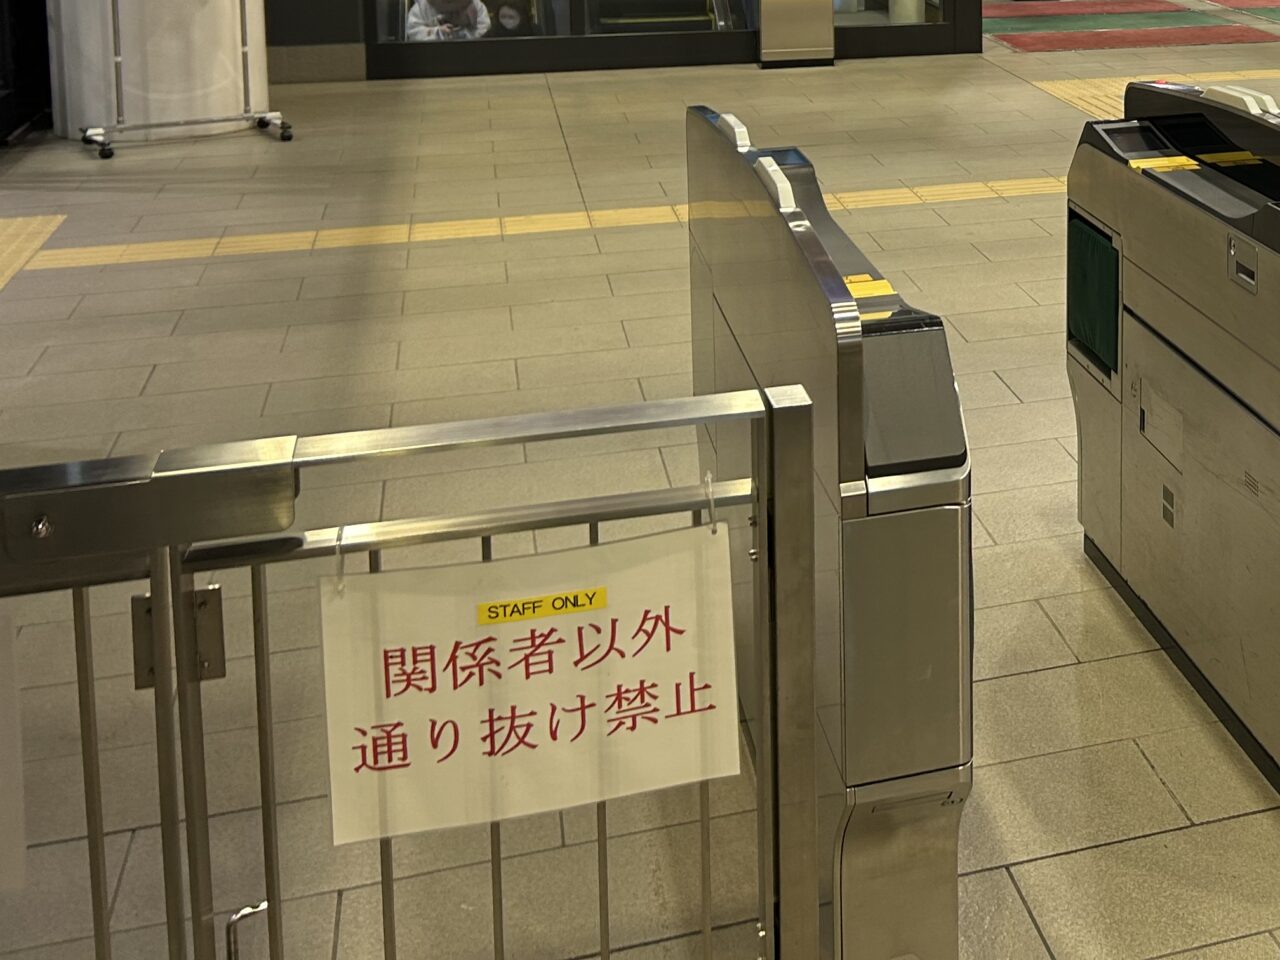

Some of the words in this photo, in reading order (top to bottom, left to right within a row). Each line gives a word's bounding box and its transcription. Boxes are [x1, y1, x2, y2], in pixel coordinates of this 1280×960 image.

[383, 604, 687, 699] 関係者以外
[487, 600, 543, 620] STAFF
[552, 592, 598, 612] ONLY
[352, 671, 718, 774] 通り抜け禁止
